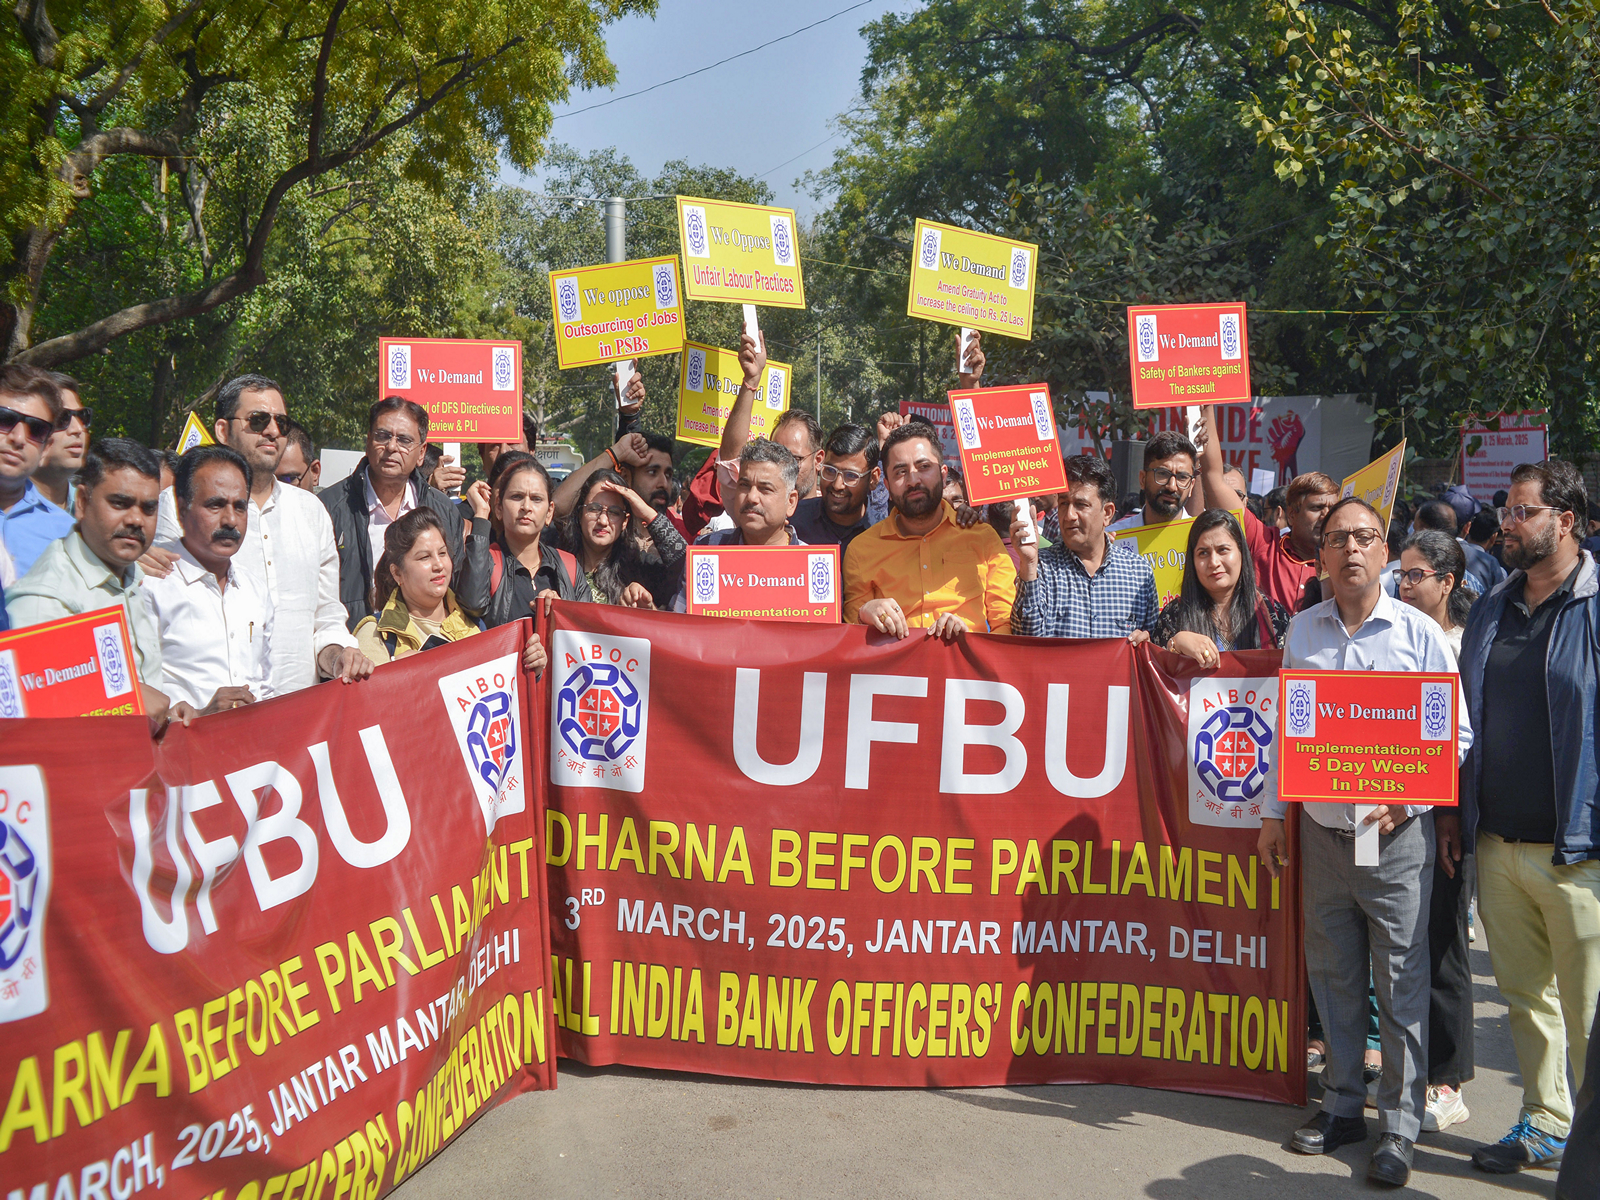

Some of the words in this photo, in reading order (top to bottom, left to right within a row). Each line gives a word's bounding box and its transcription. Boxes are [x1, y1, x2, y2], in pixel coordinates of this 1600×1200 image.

[710, 226, 729, 245] We
[732, 228, 770, 253] Oppose
[941, 252, 959, 270] We
[962, 256, 1006, 280] Demand
[693, 265, 720, 286] Unfair
[722, 267, 753, 289] Labour
[754, 270, 794, 293] Practices
[583, 288, 605, 306] We
[608, 285, 650, 307] oppose
[937, 280, 960, 296] Amend
[962, 285, 987, 304] Gratuity
[988, 291, 999, 304] Act
[1000, 294, 1007, 306] to
[917, 293, 944, 310] Increase
[946, 299, 956, 312] the
[958, 302, 978, 319] ceiling
[980, 306, 987, 319] to
[988, 308, 998, 321] Rs.
[1000, 310, 1008, 323] 25
[1009, 312, 1024, 326] Lacs
[564, 318, 634, 338] Outsourcing
[637, 314, 648, 328] of
[651, 312, 678, 326] Jobs
[599, 341, 612, 357] in
[615, 336, 648, 355] PSBs
[1159, 334, 1176, 349] We
[1178, 332, 1218, 348] Demand
[417, 369, 436, 383] We
[438, 369, 482, 384] Demand
[1140, 367, 1165, 381] Safety
[1168, 365, 1176, 378] of
[1178, 365, 1211, 377] Bankers
[1212, 363, 1241, 378] against
[706, 373, 721, 391] We
[1169, 383, 1184, 395] The
[1187, 381, 1215, 394] assault
[432, 402, 440, 413] of
[442, 402, 458, 414] DFS
[461, 402, 500, 414] Directives
[502, 406, 512, 414] on
[702, 402, 723, 418] Amend
[759, 415, 764, 427] to
[456, 420, 462, 431] &
[464, 420, 478, 432] PLI
[684, 416, 708, 432] Increase
[710, 422, 719, 435] the
[977, 416, 994, 430] We
[995, 412, 1033, 428] Demand
[1497, 435, 1514, 447] March,
[1515, 434, 1528, 446] 2025
[971, 445, 1041, 462] Implementation
[1044, 443, 1052, 452] of
[982, 465, 990, 476] 5
[993, 463, 1015, 475] Day
[1017, 458, 1049, 472] Week
[999, 480, 1010, 491] In
[1013, 475, 1040, 489] PSBs
[1144, 551, 1165, 570] We
[721, 574, 744, 587] We
[748, 574, 805, 587] Demand
[702, 608, 809, 617] Implementation
[813, 607, 828, 616] of
[565, 645, 639, 672] AIBOC
[20, 672, 44, 692] We
[44, 656, 97, 686] Demand
[1203, 689, 1272, 712] AIBOC
[1318, 702, 1345, 719] We
[1349, 703, 1417, 720] Demand
[732, 667, 1130, 798] UFBU
[1296, 742, 1421, 756] Implementation
[1426, 745, 1443, 756] of
[593, 764, 605, 778] बी
[1309, 758, 1320, 771] 5
[1327, 758, 1366, 775] Day
[1372, 760, 1429, 774] Week
[1331, 778, 1351, 791] In
[1357, 779, 1405, 793] PSBs
[1231, 805, 1243, 819] बी
[129, 724, 411, 954] UFBU
[546, 808, 755, 885] DHARNA
[769, 828, 975, 894] BEFORE
[990, 838, 1283, 910] PARLIAMENT
[564, 888, 605, 930] 3RD
[617, 898, 755, 951] MARCH,
[766, 913, 854, 958] 2025,
[865, 919, 1001, 954] JANTAR
[1012, 920, 1156, 962] MANTAR,
[1169, 925, 1266, 969] DELHI
[551, 954, 600, 1036] ALL
[610, 960, 705, 1043] INDIA
[717, 970, 818, 1053] BANK
[826, 979, 1003, 1058] OFFICERS'
[1010, 981, 1288, 1073] CONFEDERATION
[174, 955, 320, 1094] BEFORE
[7, 1132, 165, 1200] ARCH,
[171, 1104, 272, 1170] 2025,
[268, 1044, 368, 1136] JANTAR
[366, 976, 466, 1074] MANTAR,
[468, 928, 520, 996] DELHI
[393, 986, 546, 1186] CONFEDERATION
